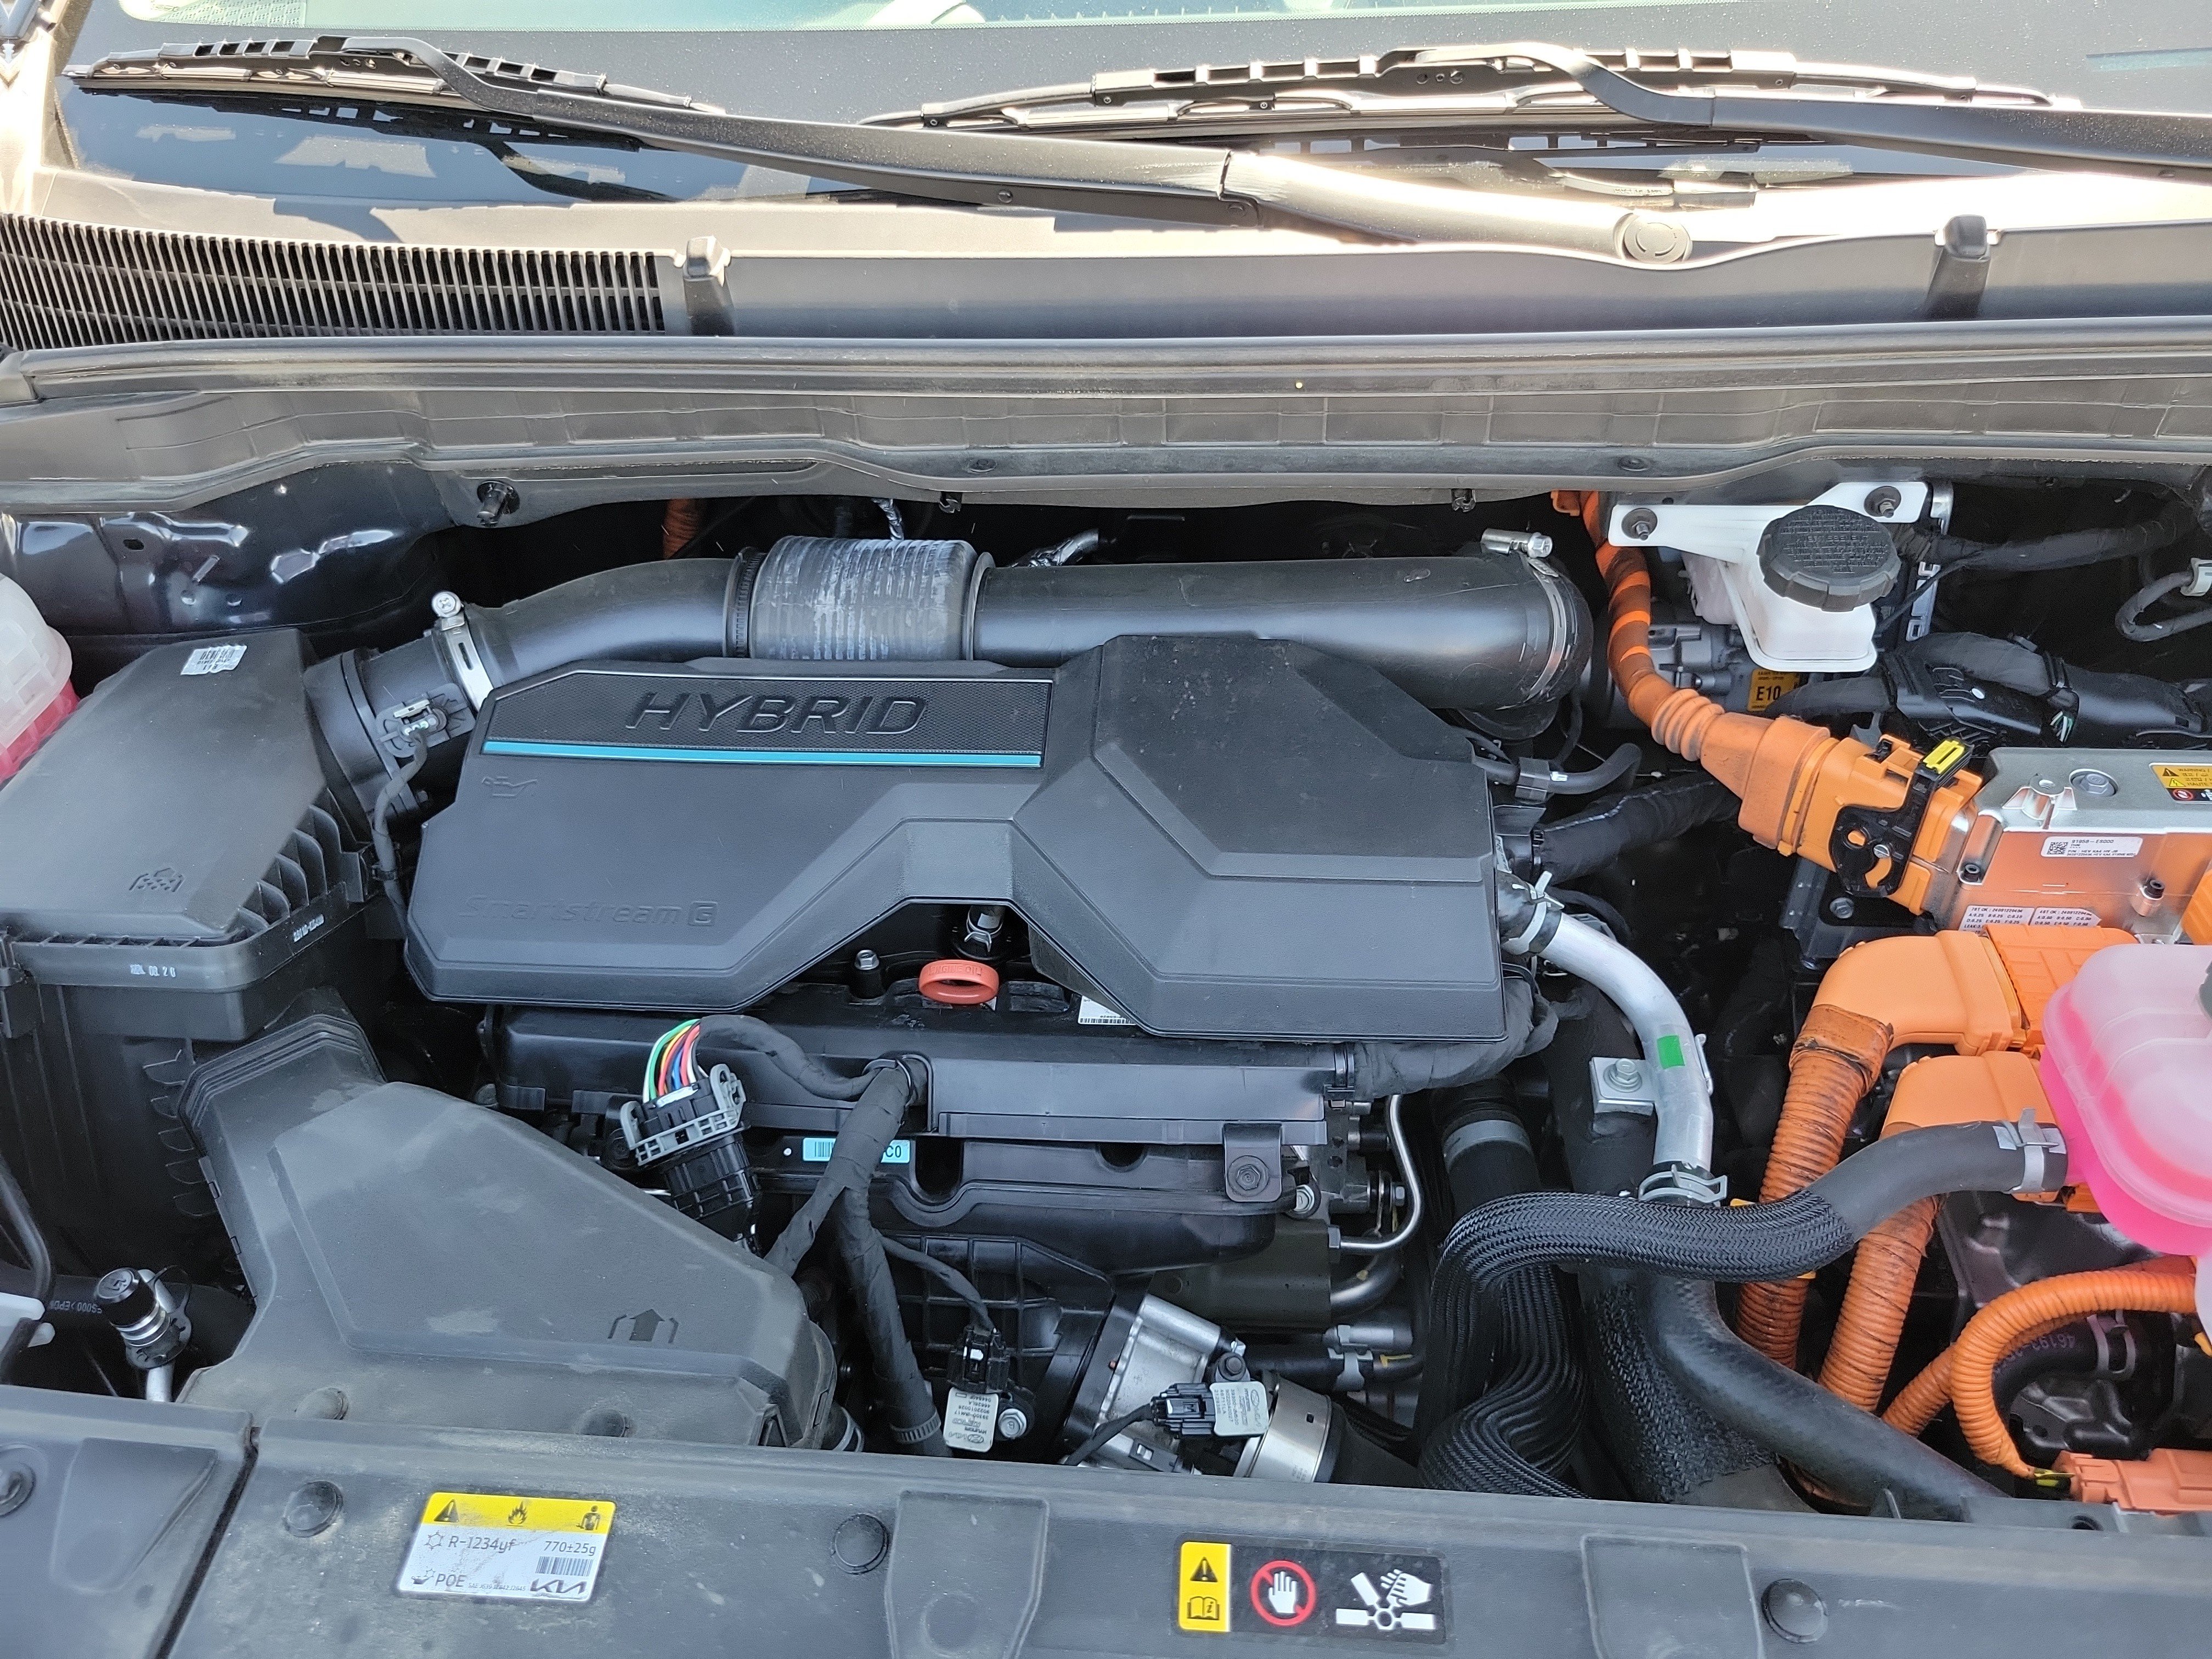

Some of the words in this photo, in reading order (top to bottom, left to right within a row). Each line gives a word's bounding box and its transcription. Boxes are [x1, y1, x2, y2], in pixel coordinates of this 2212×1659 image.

[1756, 685, 1781, 701] E10
[625, 692, 928, 735] HYBRID
[966, 966, 983, 977] OIL
[448, 1535, 517, 1553] R-1234yf
[544, 1541, 596, 1556] 770±25g
[435, 1573, 467, 1587] POE
[530, 1578, 587, 1595] KIA
